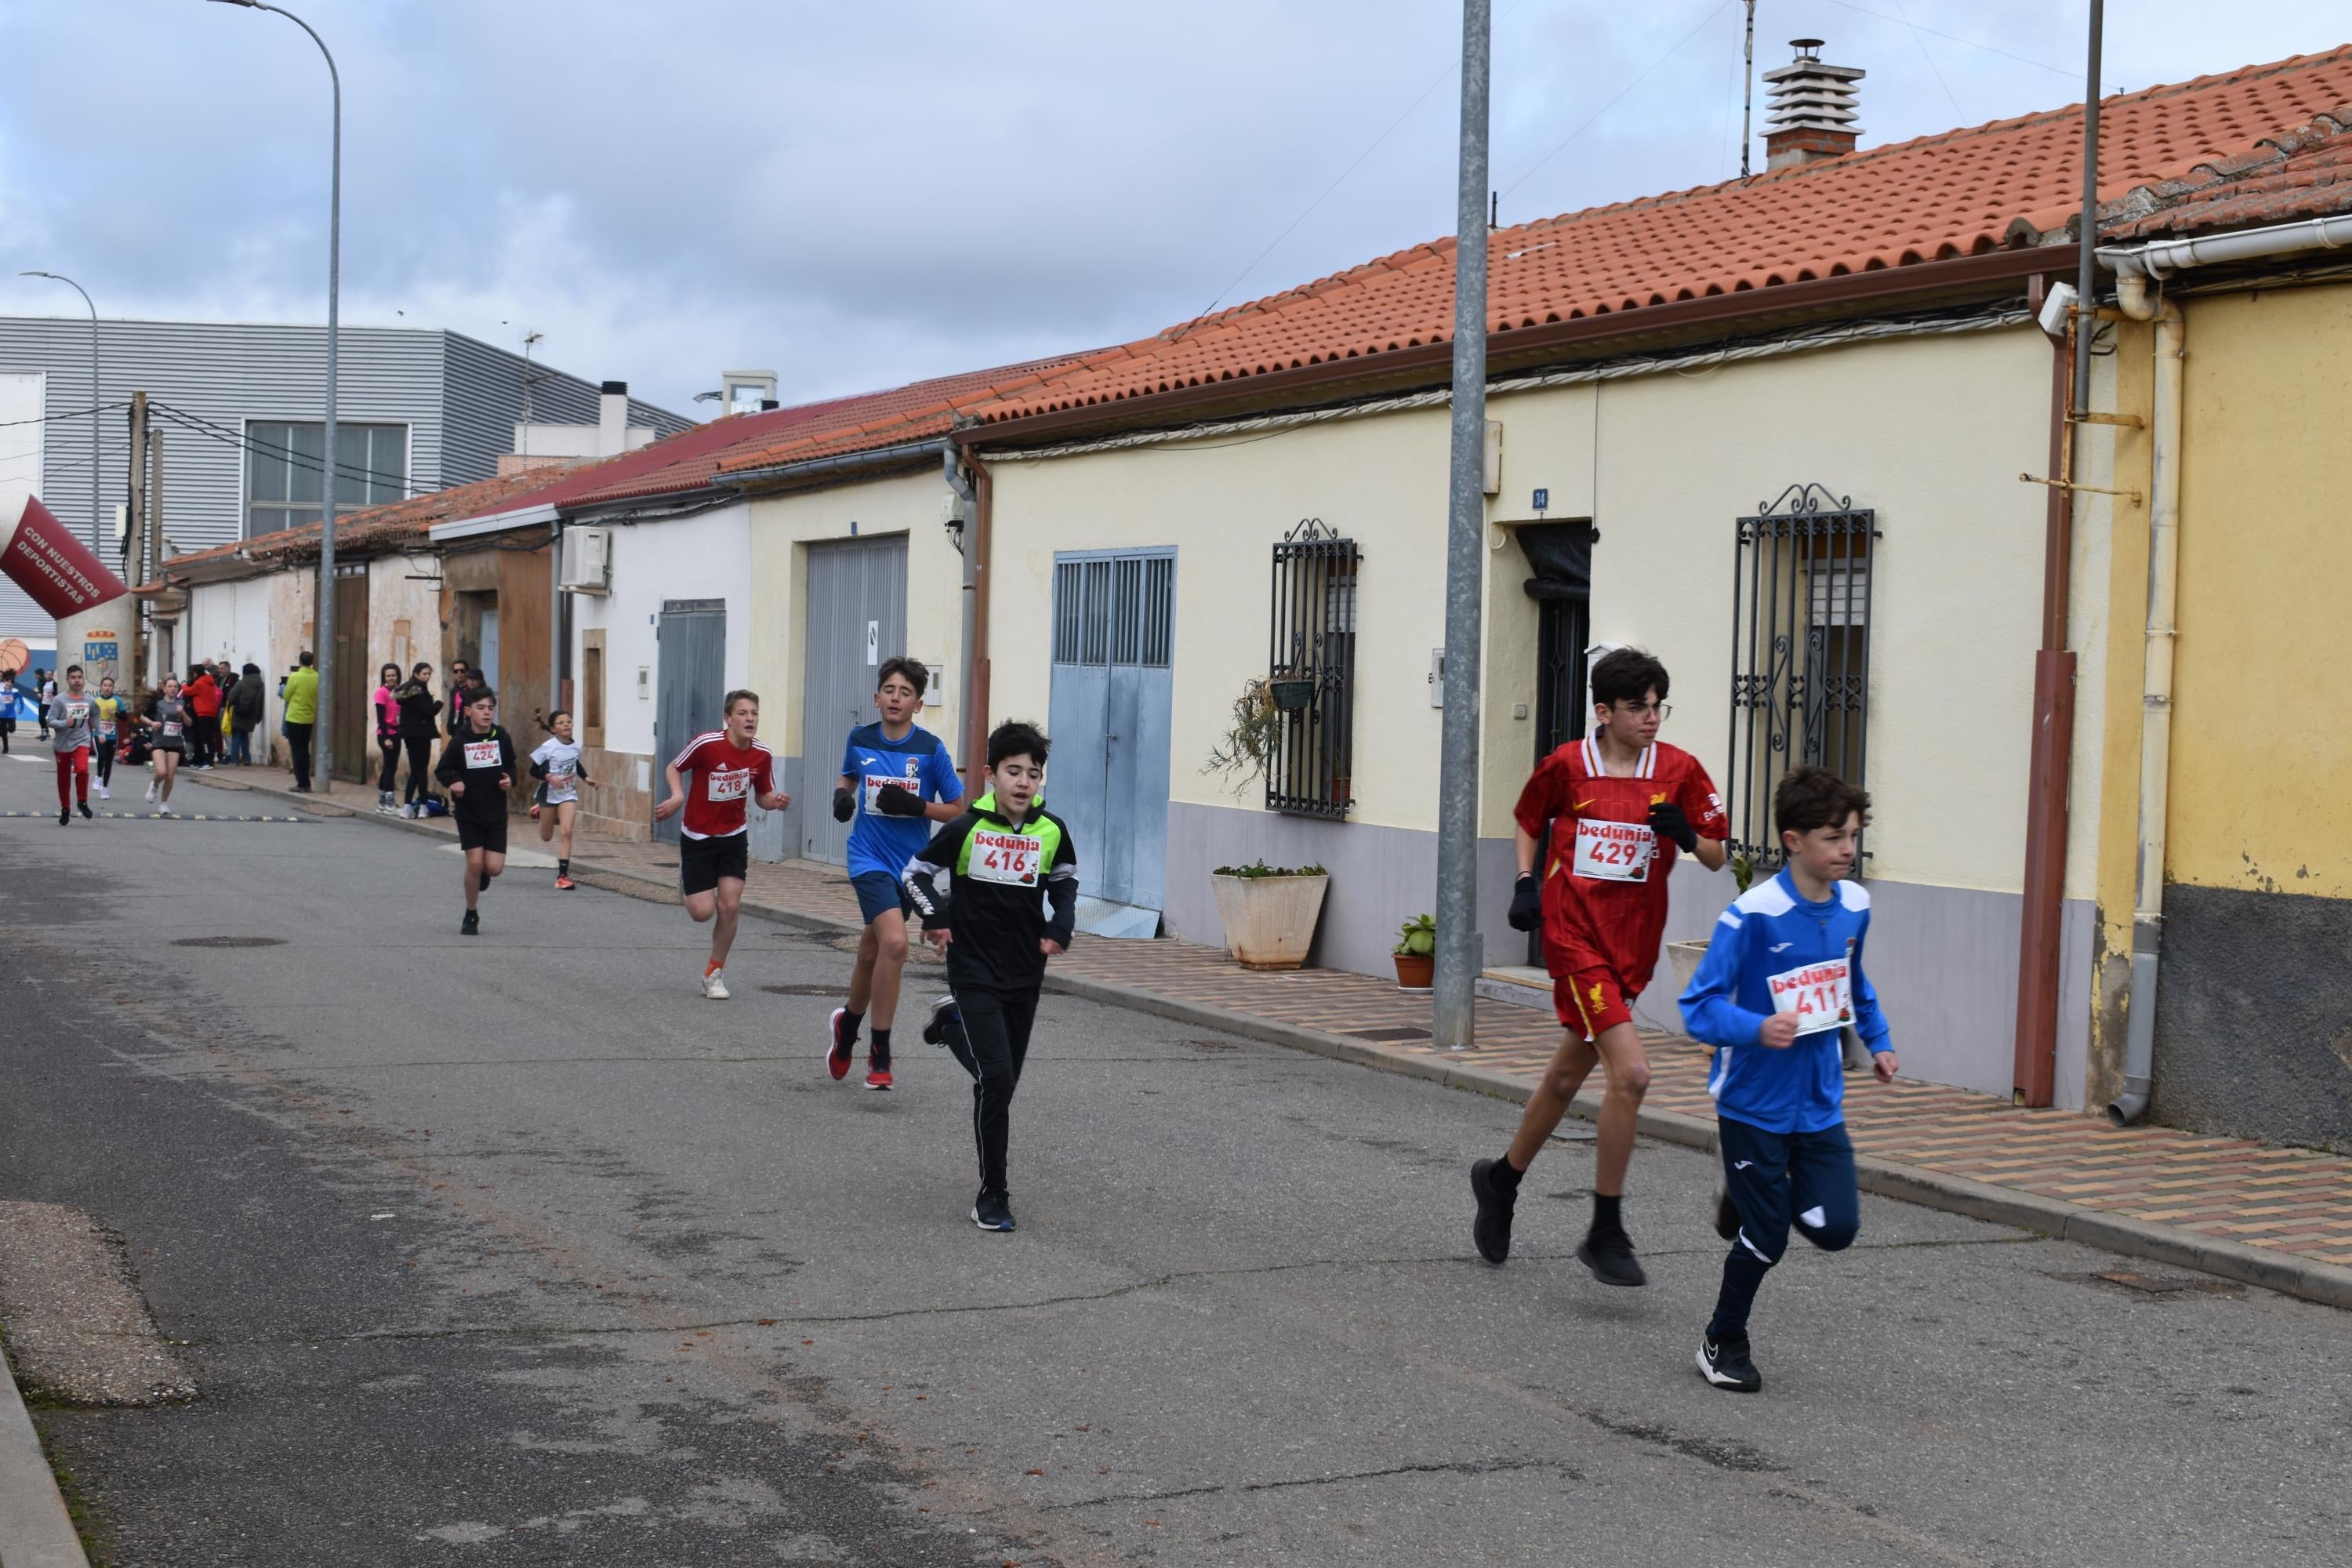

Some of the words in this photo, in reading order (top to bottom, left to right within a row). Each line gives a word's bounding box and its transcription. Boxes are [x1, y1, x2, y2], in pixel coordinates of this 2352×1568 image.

[1535, 492, 1544, 506] 34
[24, 527, 48, 549] CON
[47, 548, 100, 597] NUESTROS
[16, 541, 85, 604] DEPORTISTAS
[473, 750, 493, 760] 424
[710, 771, 749, 781] bedunia
[867, 777, 919, 790] bednia
[717, 780, 741, 793] 418
[975, 832, 1040, 851] bedunia
[1579, 822, 1652, 842] bedunia
[984, 850, 1025, 872] 416
[1589, 841, 1637, 865] 429
[1772, 964, 1847, 994] bedunia
[1795, 984, 1838, 1014] 411
